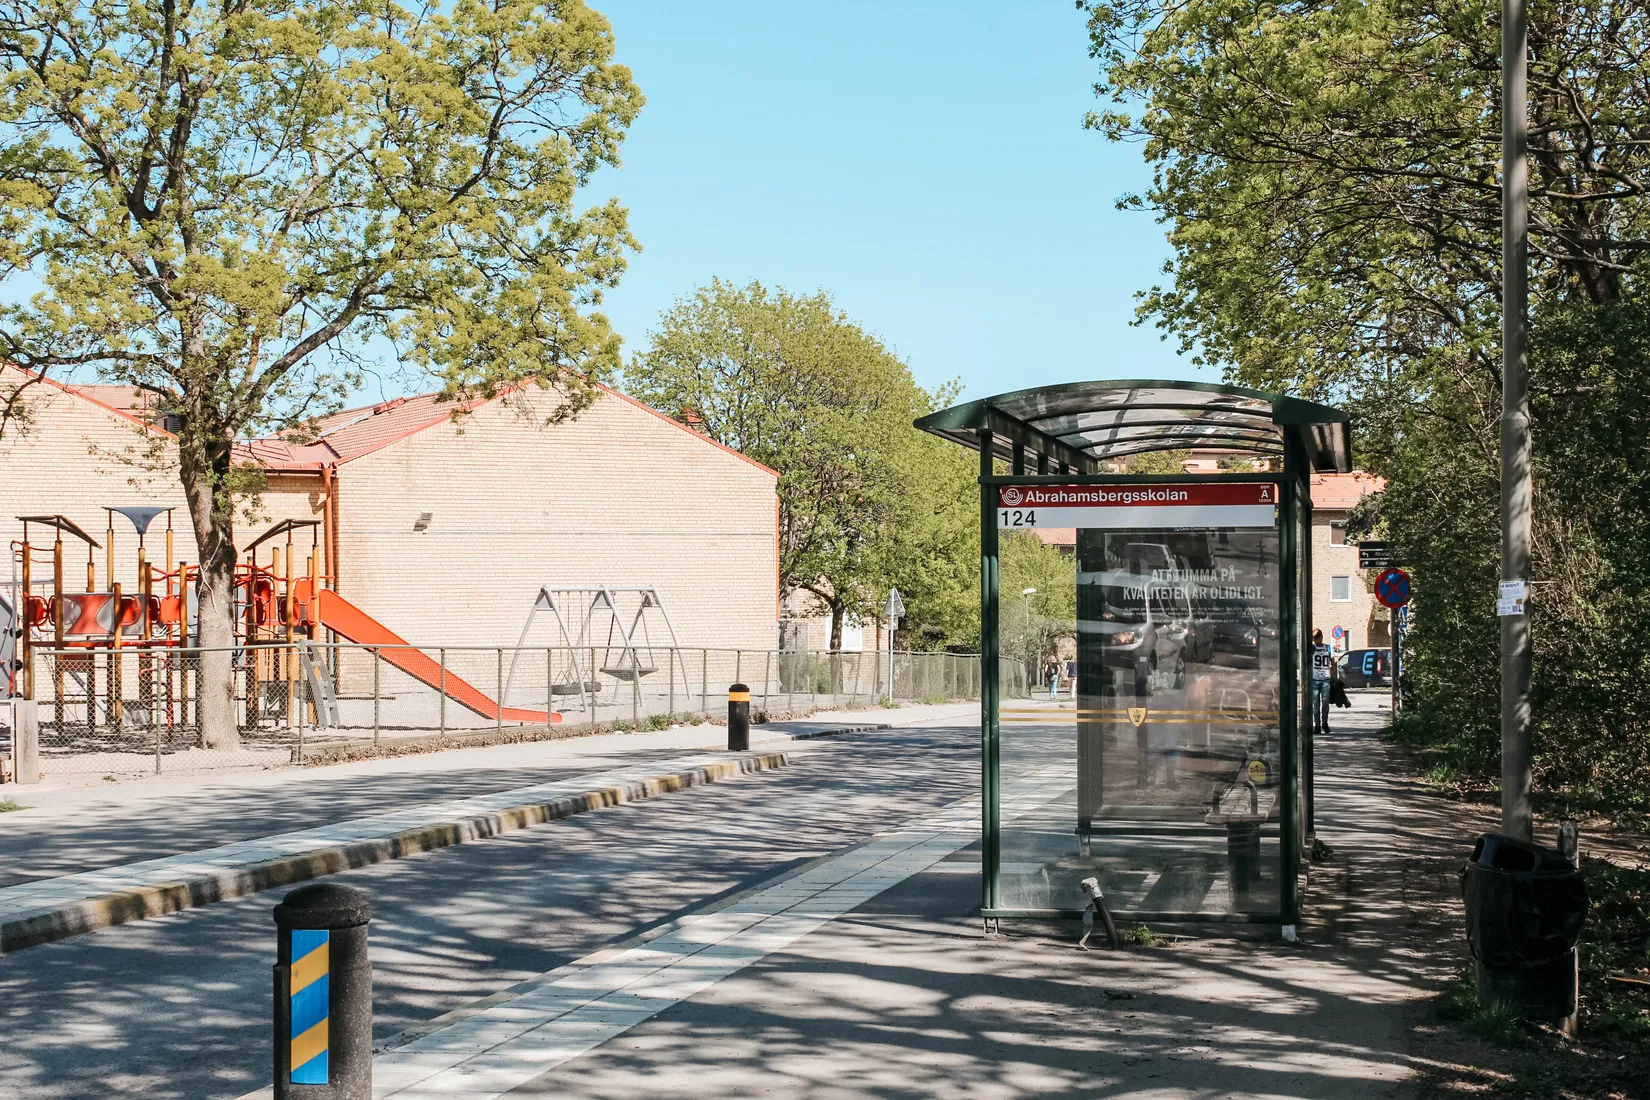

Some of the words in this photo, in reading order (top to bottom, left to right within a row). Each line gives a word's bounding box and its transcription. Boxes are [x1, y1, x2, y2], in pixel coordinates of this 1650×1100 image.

[1007, 491, 1017, 499] SL
[1025, 489, 1188, 503] Abrahamsbergsskolan
[1261, 489, 1269, 498] A
[1001, 510, 1037, 526] 124
[1221, 565, 1236, 582] PÅ
[1123, 586, 1190, 600] KVALITETEN
[1191, 583, 1207, 600] ÄR
[1210, 586, 1265, 600] OLIDLIGT.
[1314, 655, 1329, 667] 90
